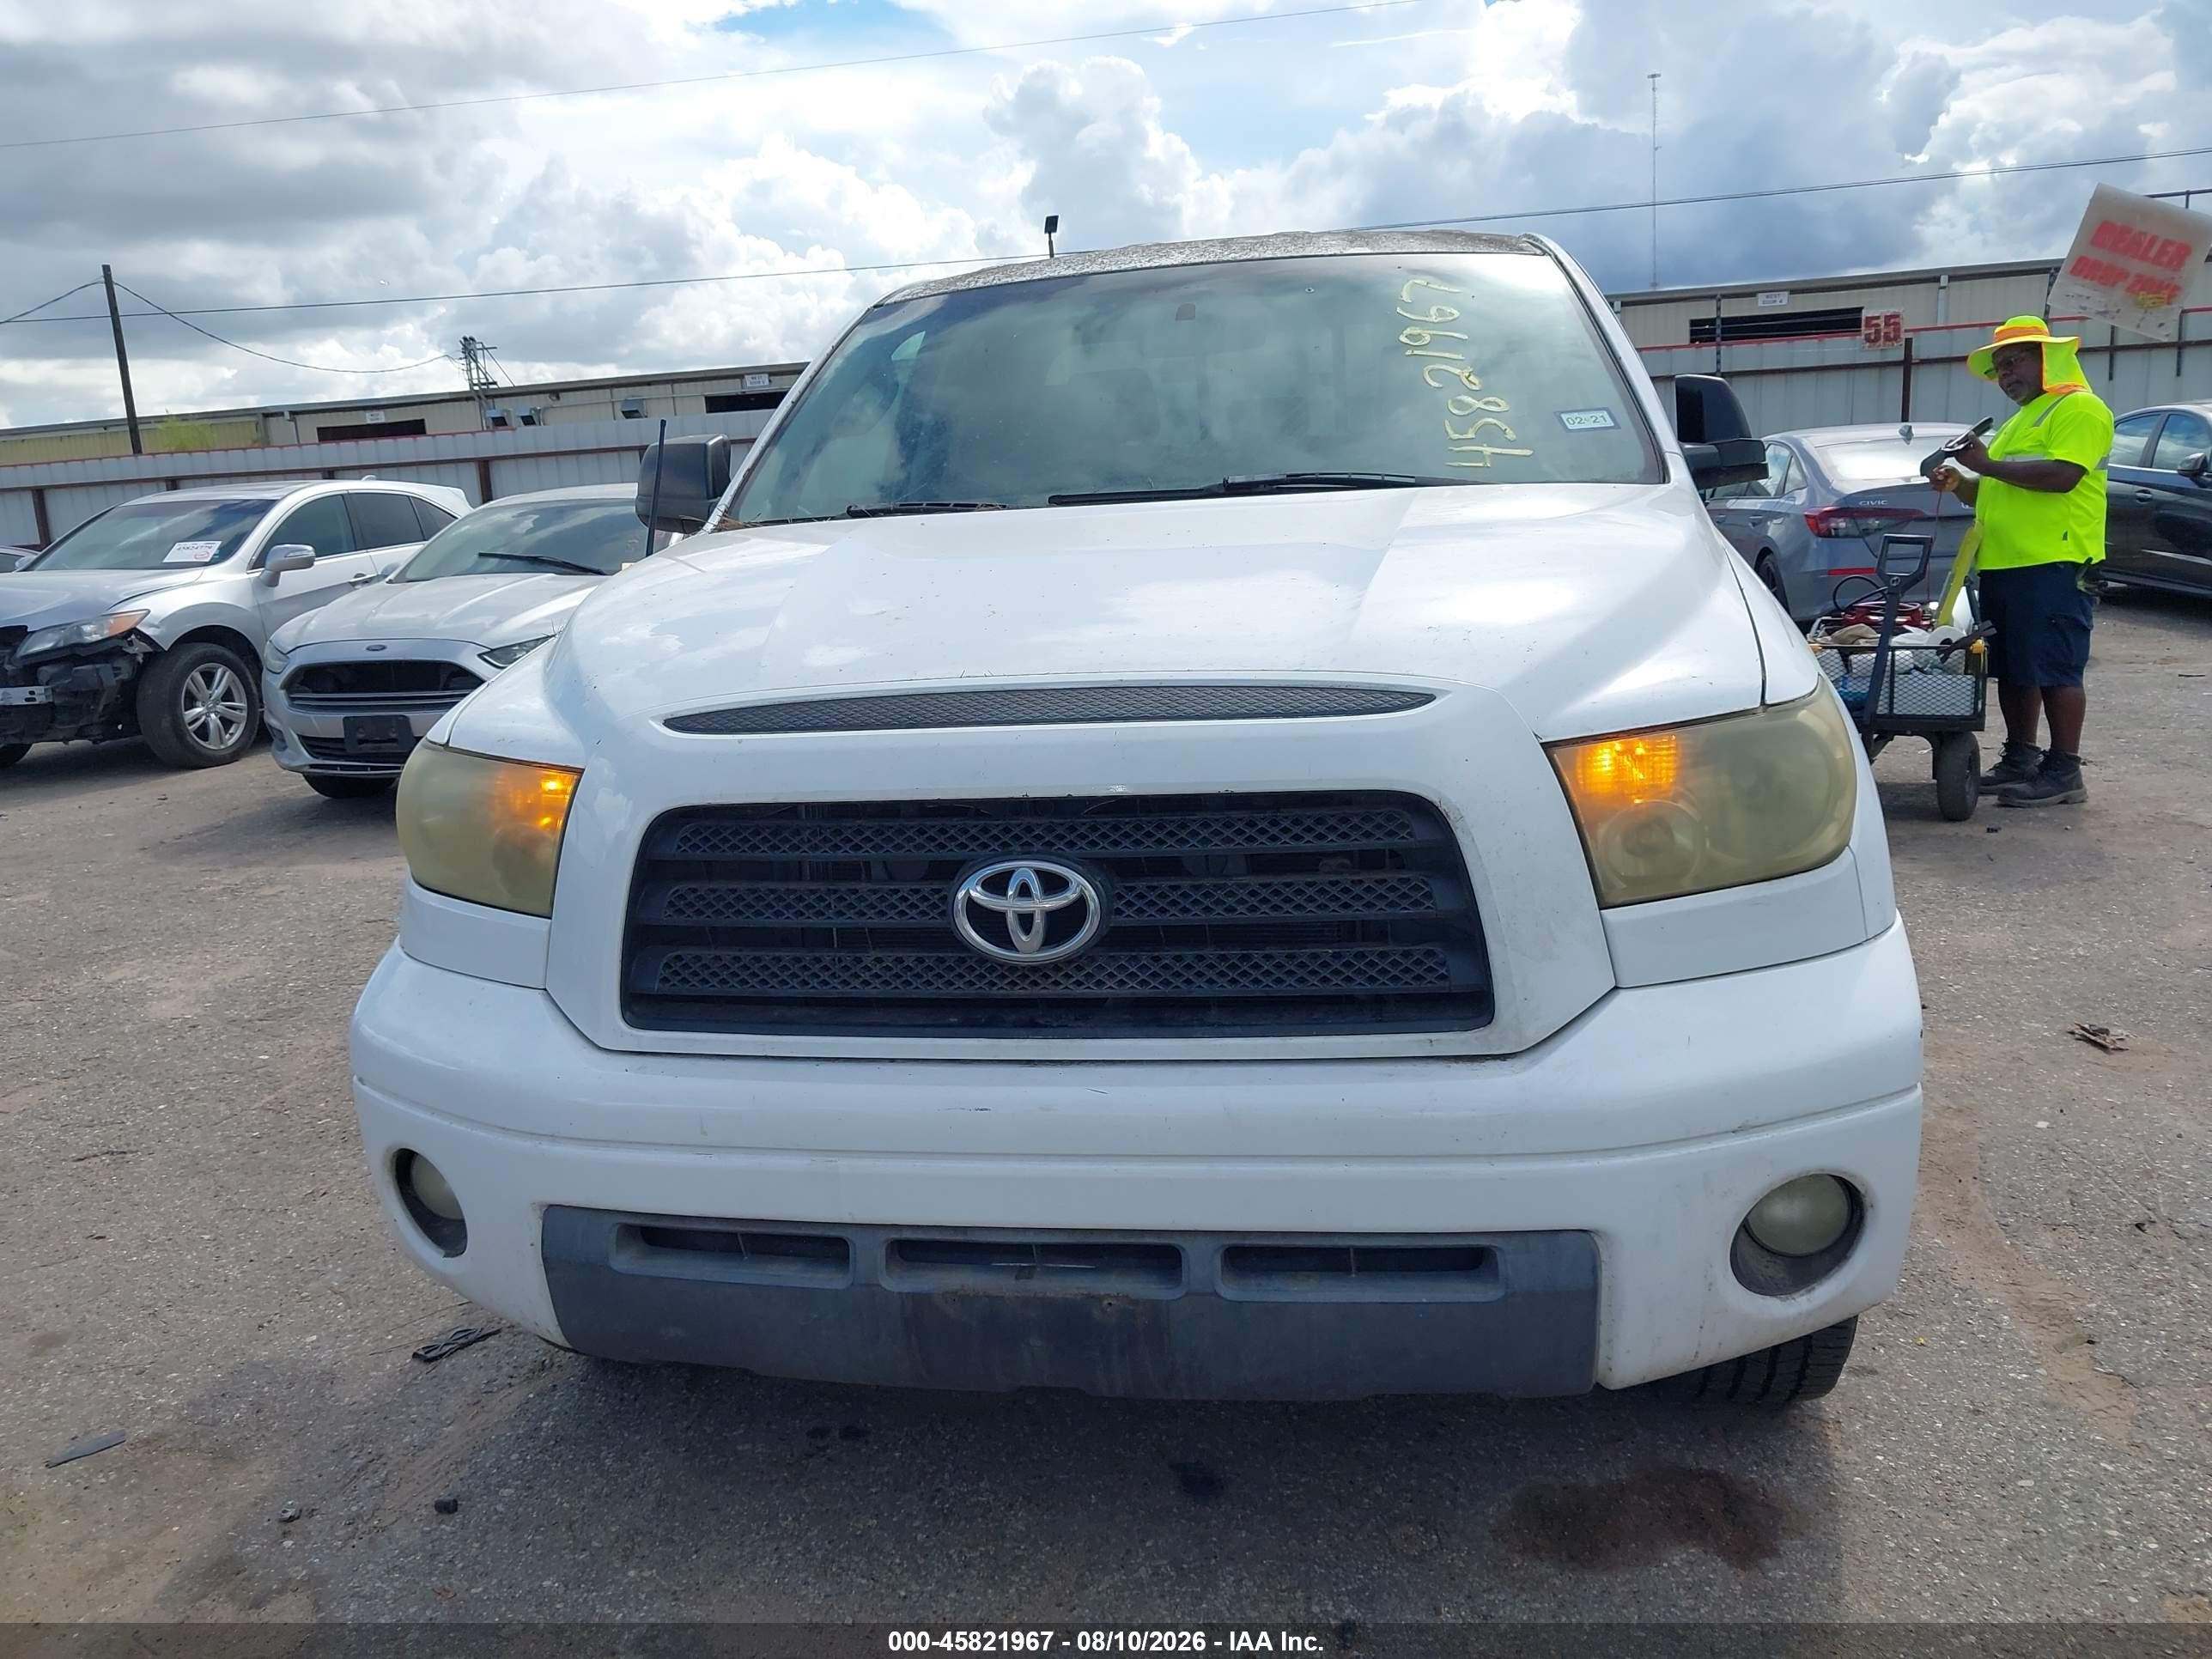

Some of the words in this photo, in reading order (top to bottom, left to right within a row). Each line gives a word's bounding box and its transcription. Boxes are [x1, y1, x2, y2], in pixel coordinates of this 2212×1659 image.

[2090, 220, 2191, 271] DEALER
[1864, 313, 1902, 343] 55
[1396, 279, 1534, 467] 45821967
